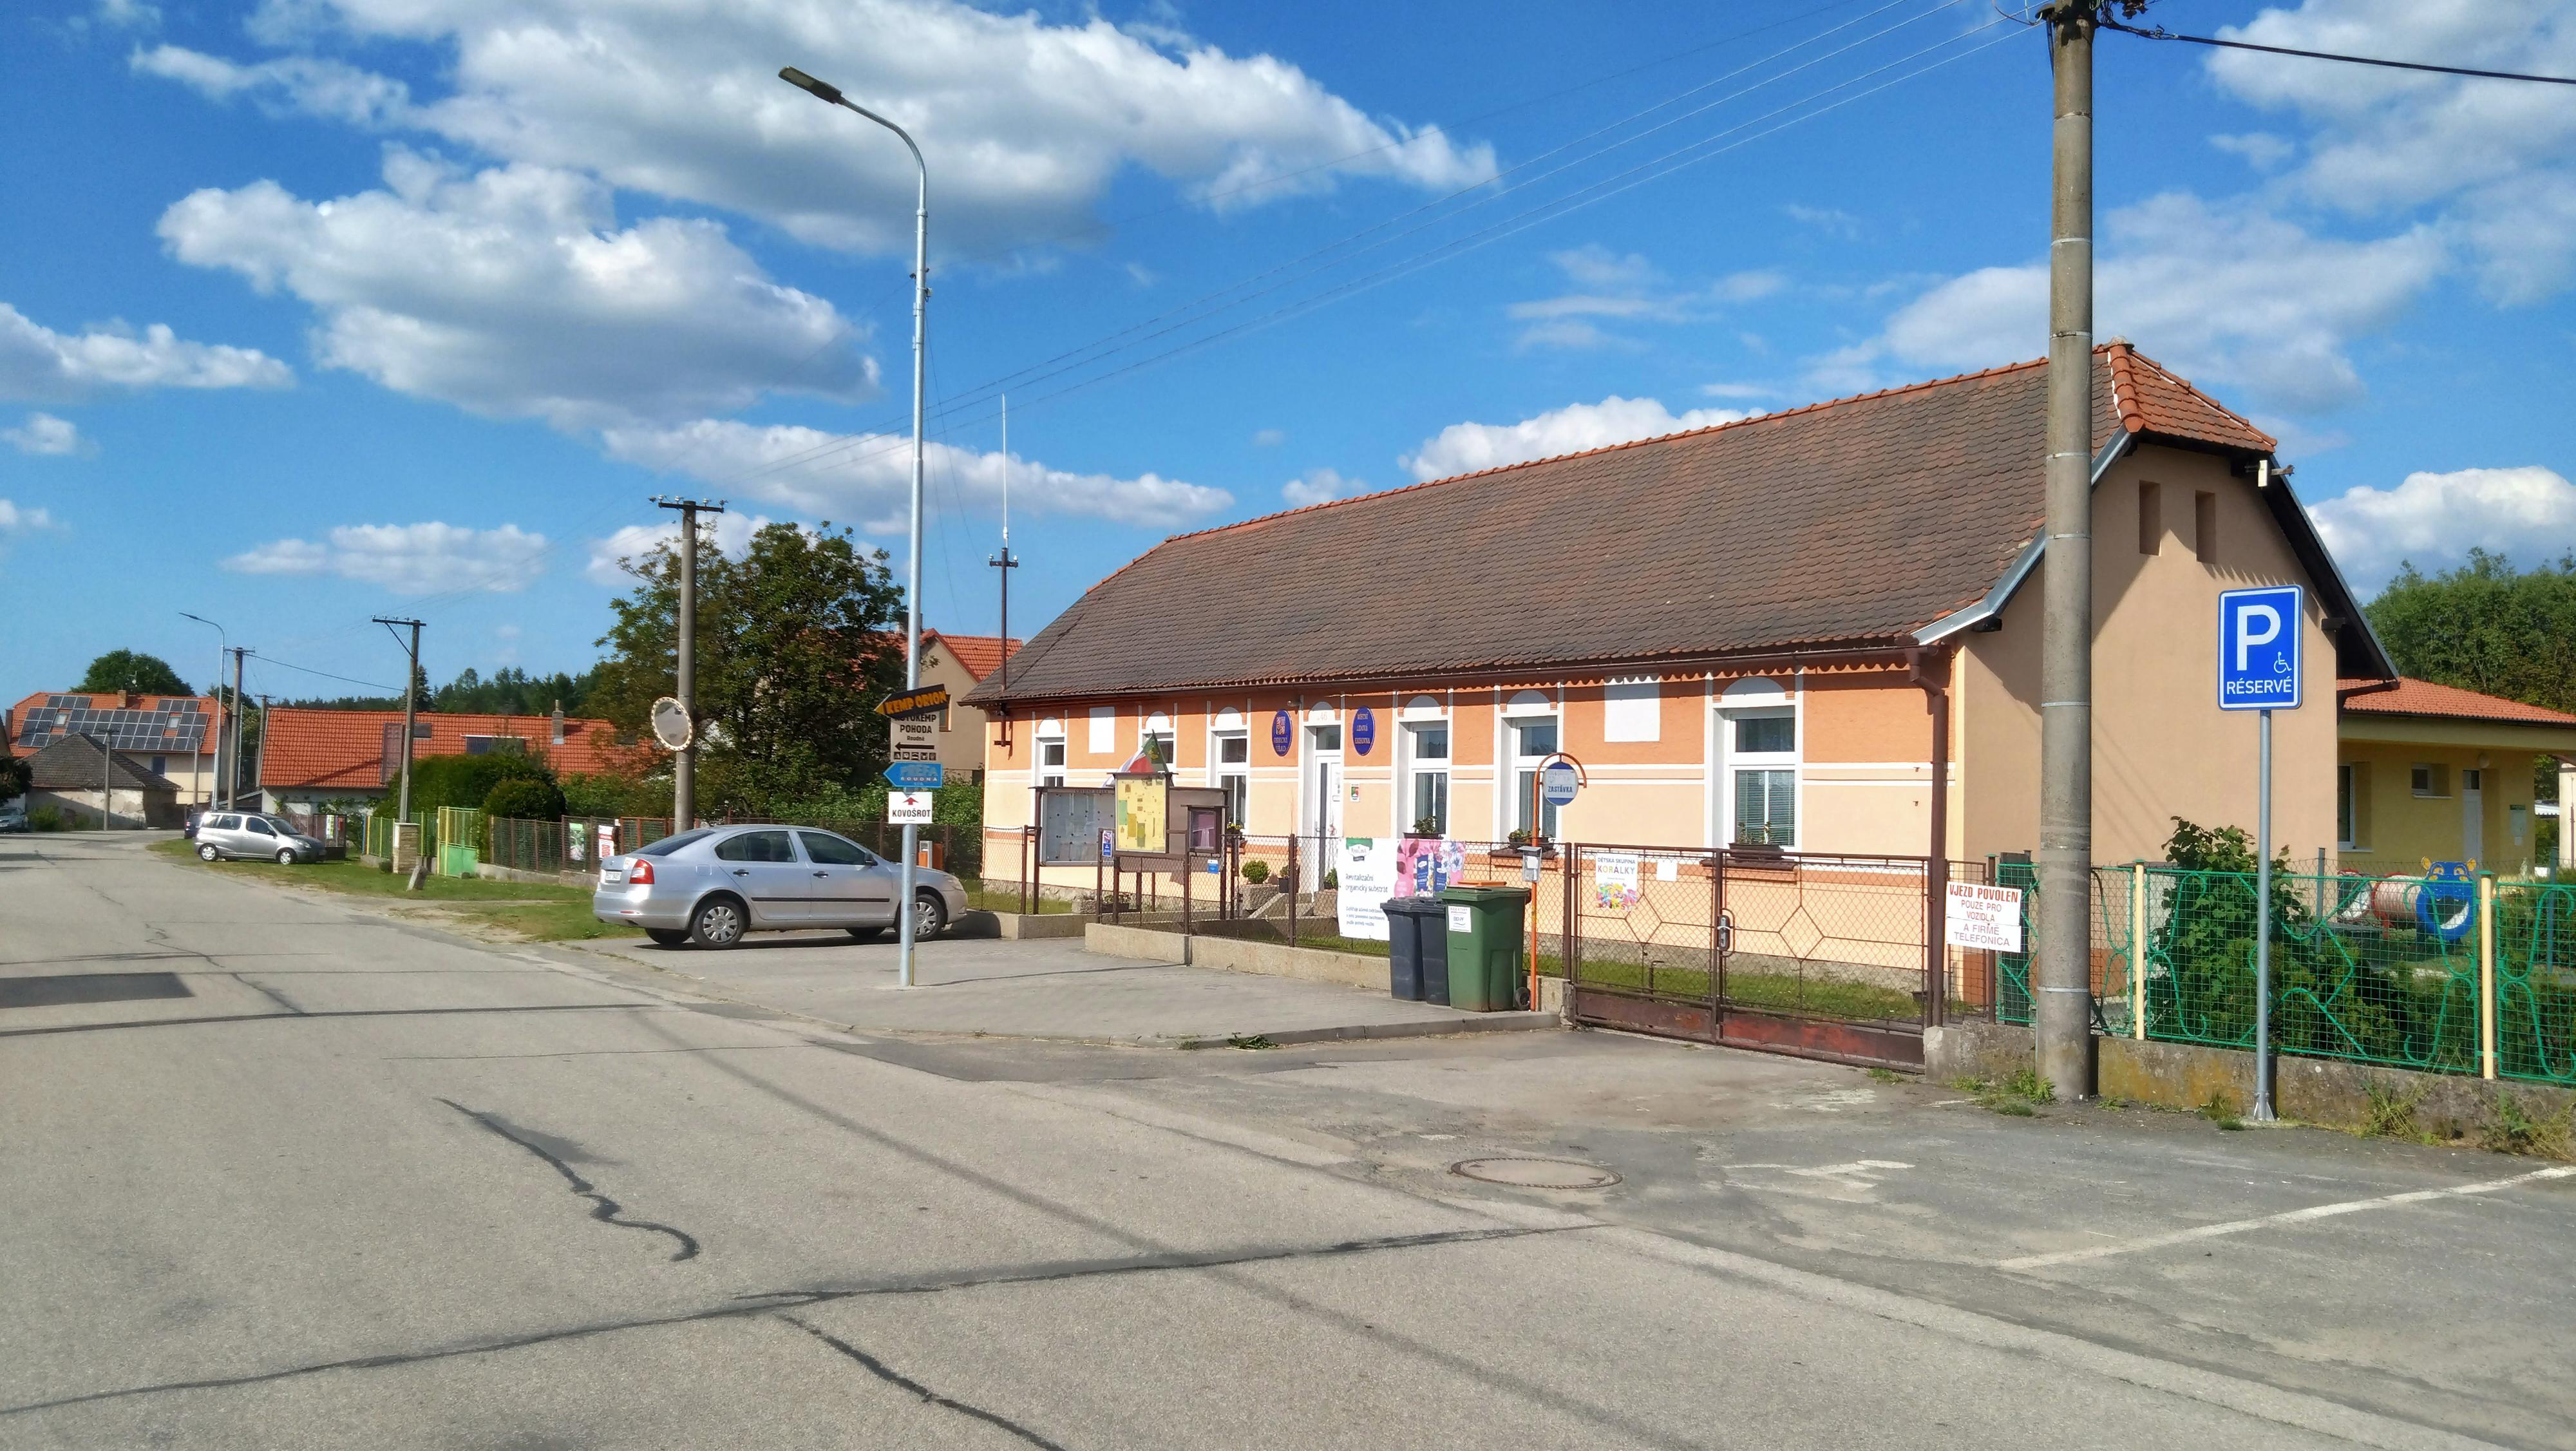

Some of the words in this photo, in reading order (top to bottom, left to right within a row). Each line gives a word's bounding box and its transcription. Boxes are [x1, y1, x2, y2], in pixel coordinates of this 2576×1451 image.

[2237, 605, 2281, 670] P
[2227, 676, 2291, 694] RÉSERVÉ
[886, 697, 914, 714] KEMP
[915, 690, 947, 708] ORION
[900, 725, 932, 734] POHODA
[892, 808, 931, 817] KOVOŠROT
[1598, 864, 1635, 874] KORÁLKY
[1950, 884, 1973, 897] VJEZD
[1977, 888, 2018, 903] POVOLEN
[1961, 900, 1983, 910] POUZE
[1987, 903, 2002, 912] PRO
[1967, 911, 1995, 922] VOZIDLA
[1954, 932, 2010, 946] TELEFONICA
